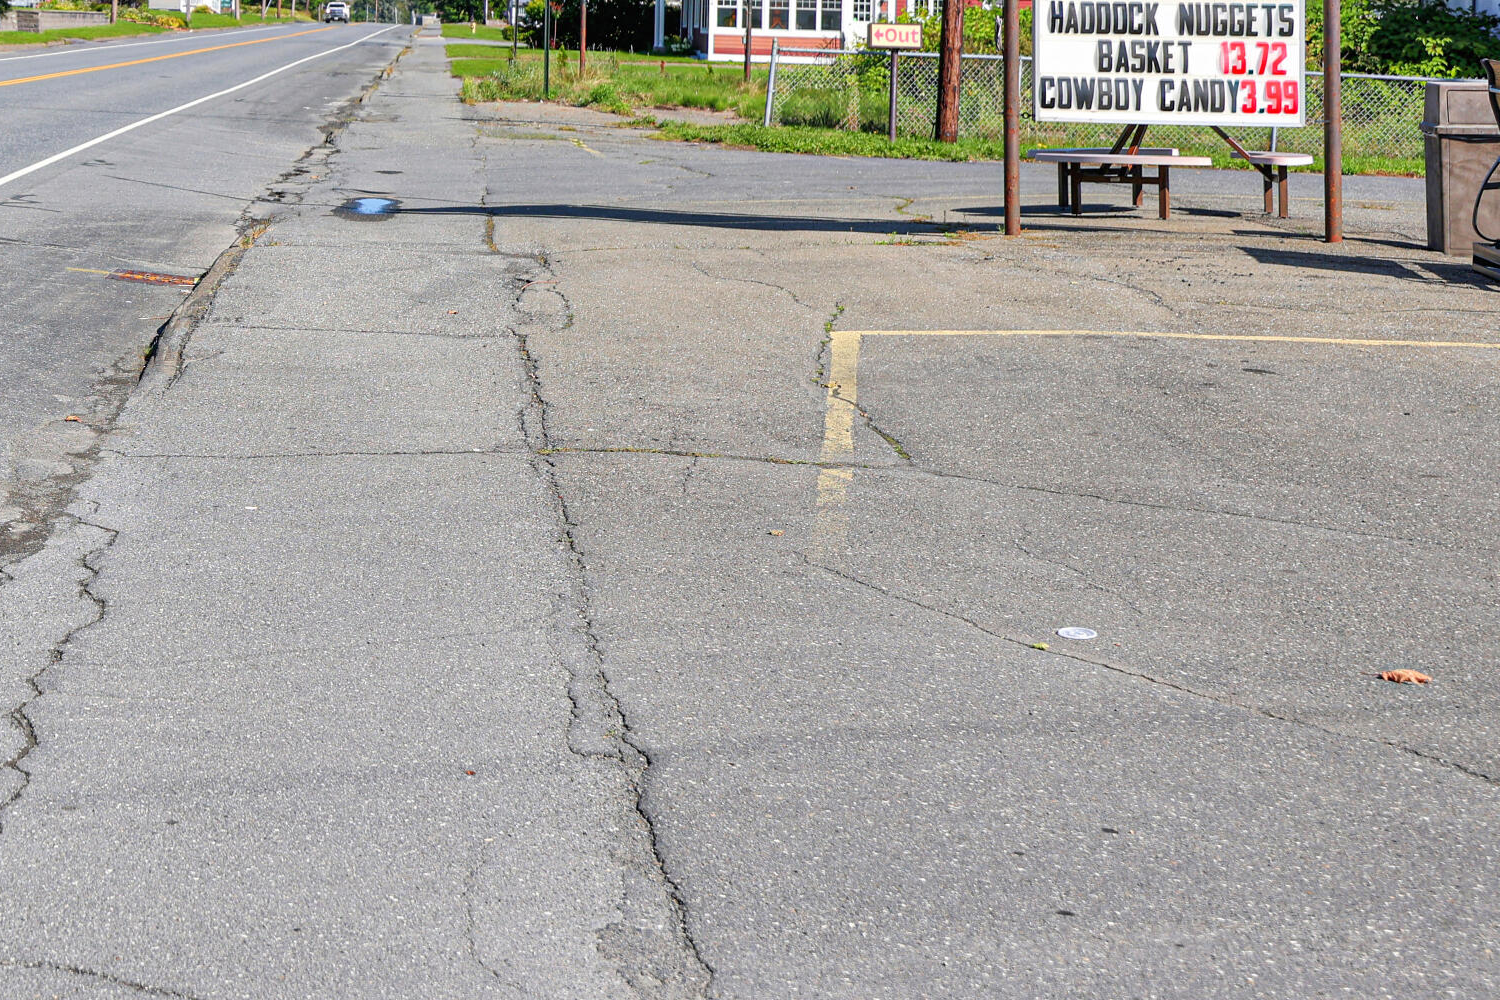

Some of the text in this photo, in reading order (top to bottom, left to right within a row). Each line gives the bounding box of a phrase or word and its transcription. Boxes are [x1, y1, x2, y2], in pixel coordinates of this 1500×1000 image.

[885, 28, 919, 43] Out
[1050, 0, 1295, 37] HADDOCK NUGGETS
[1097, 39, 1288, 76] BASKET 13.72
[1040, 76, 1299, 114] COWBOY CANDY 3.99
